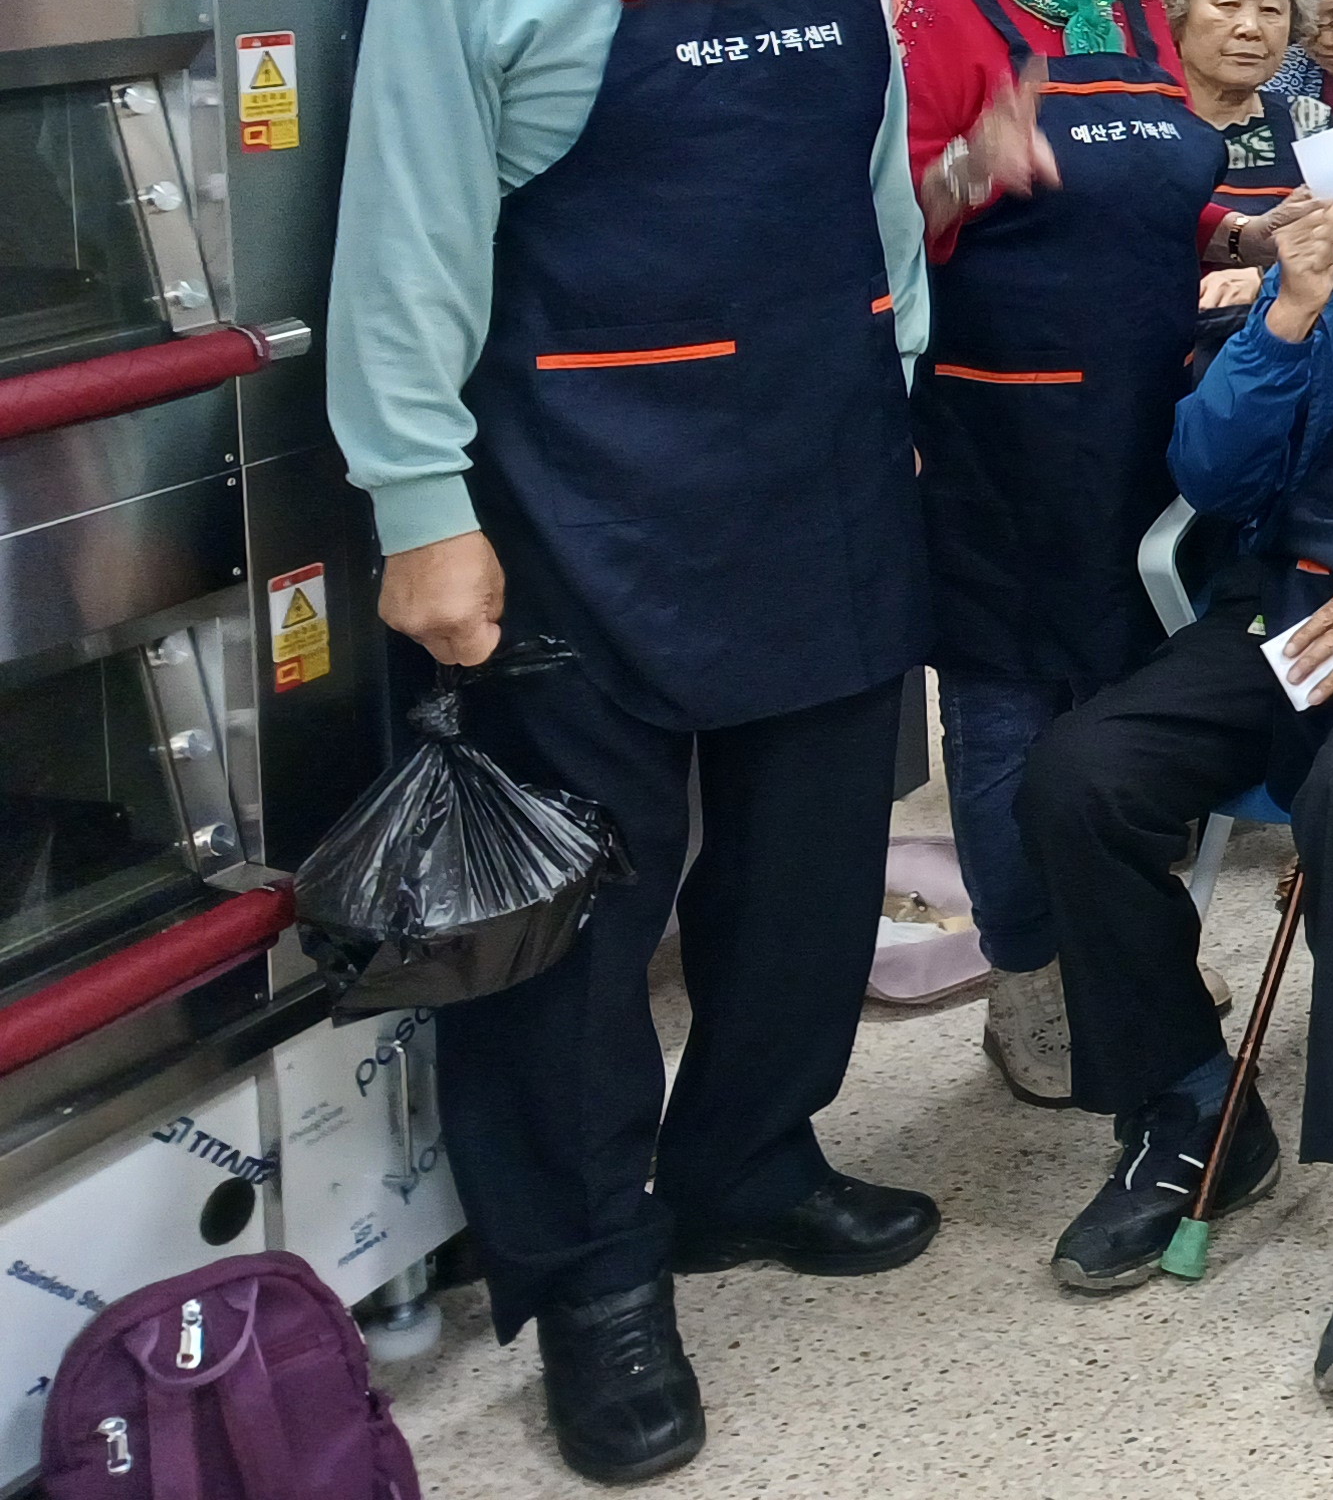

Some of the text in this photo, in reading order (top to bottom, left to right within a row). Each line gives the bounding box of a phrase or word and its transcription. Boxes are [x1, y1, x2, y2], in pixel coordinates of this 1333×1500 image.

[675, 21, 843, 66] 예산군 가족센터
[1070, 120, 1182, 143] 예산군 가족센터
